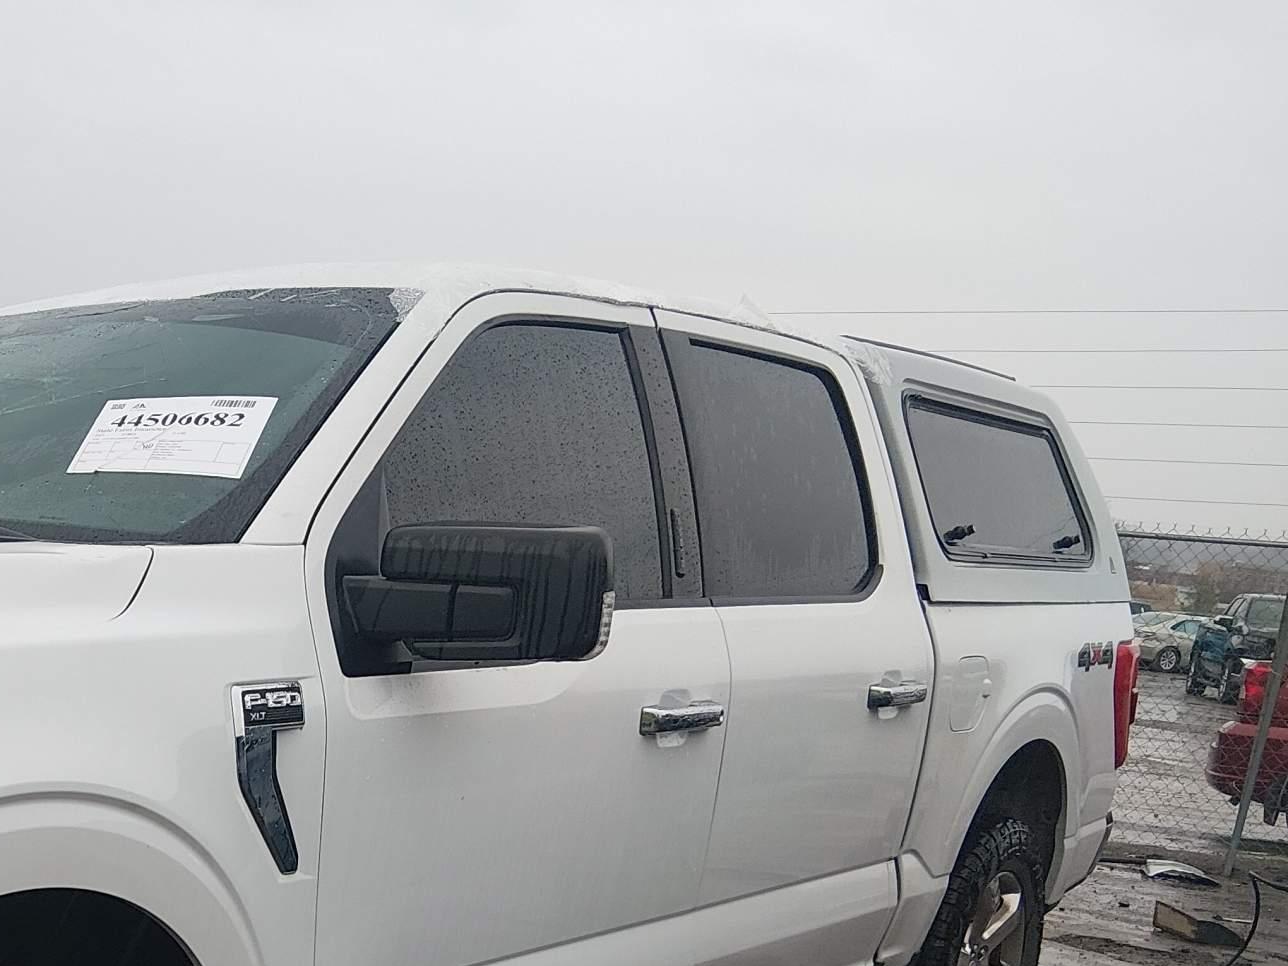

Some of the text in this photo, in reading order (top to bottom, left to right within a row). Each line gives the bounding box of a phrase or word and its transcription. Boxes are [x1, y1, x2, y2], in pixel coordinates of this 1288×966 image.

[111, 412, 245, 427] 44506682
[244, 691, 301, 709] F-150
[250, 711, 266, 720] XLT
